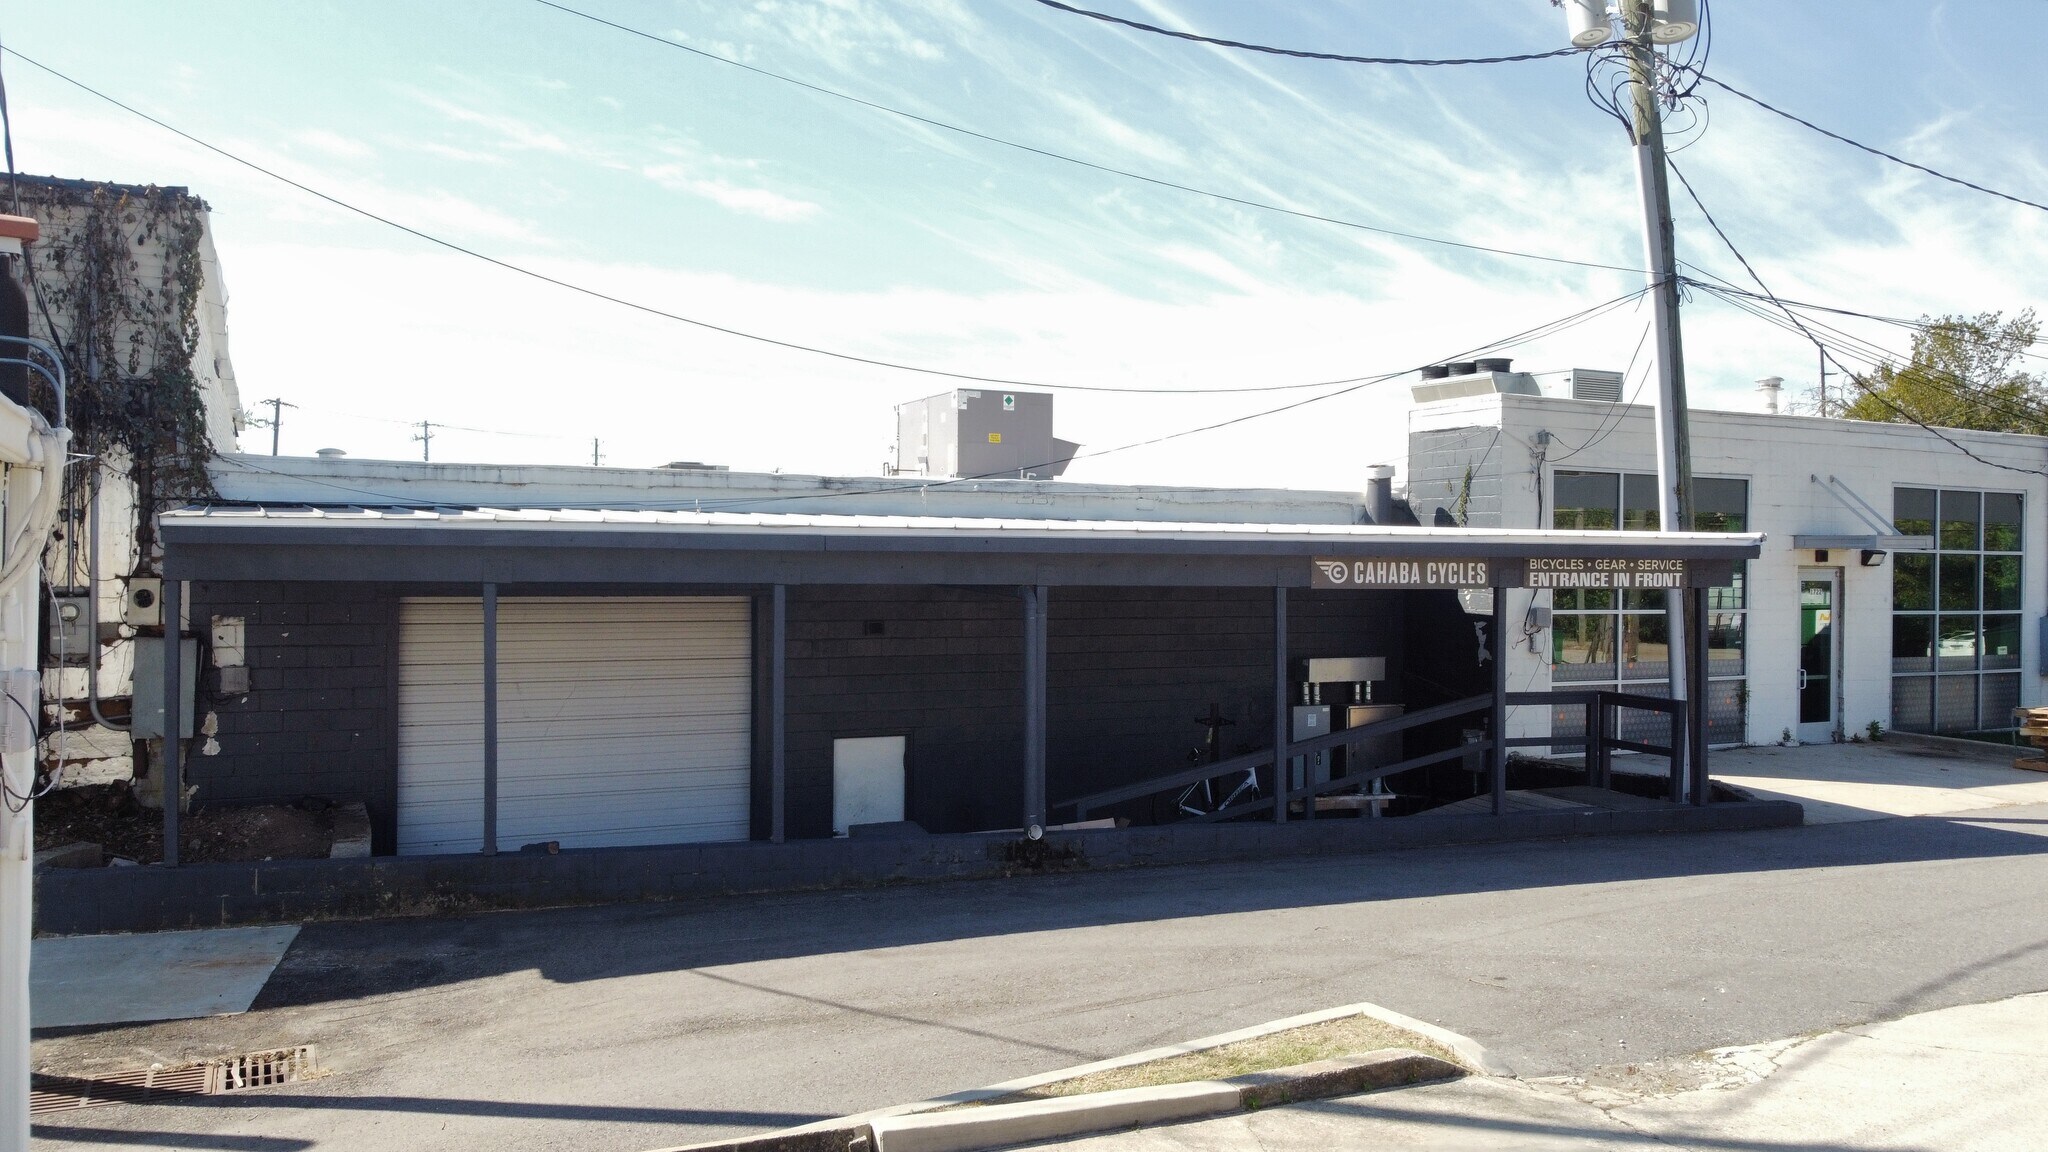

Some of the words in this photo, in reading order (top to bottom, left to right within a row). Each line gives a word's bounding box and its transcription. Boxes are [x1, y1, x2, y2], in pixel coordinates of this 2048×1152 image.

[1529, 558, 1584, 570] BICYCLES
[1595, 559, 1626, 570] GEAR
[1637, 559, 1683, 570] SERVICE
[1354, 561, 1421, 584] CAHABA
[1427, 562, 1485, 584] CYCLES
[1529, 572, 1609, 587] ENTRANCE
[1613, 572, 1630, 587] IN
[1635, 572, 1683, 587] FRONT
